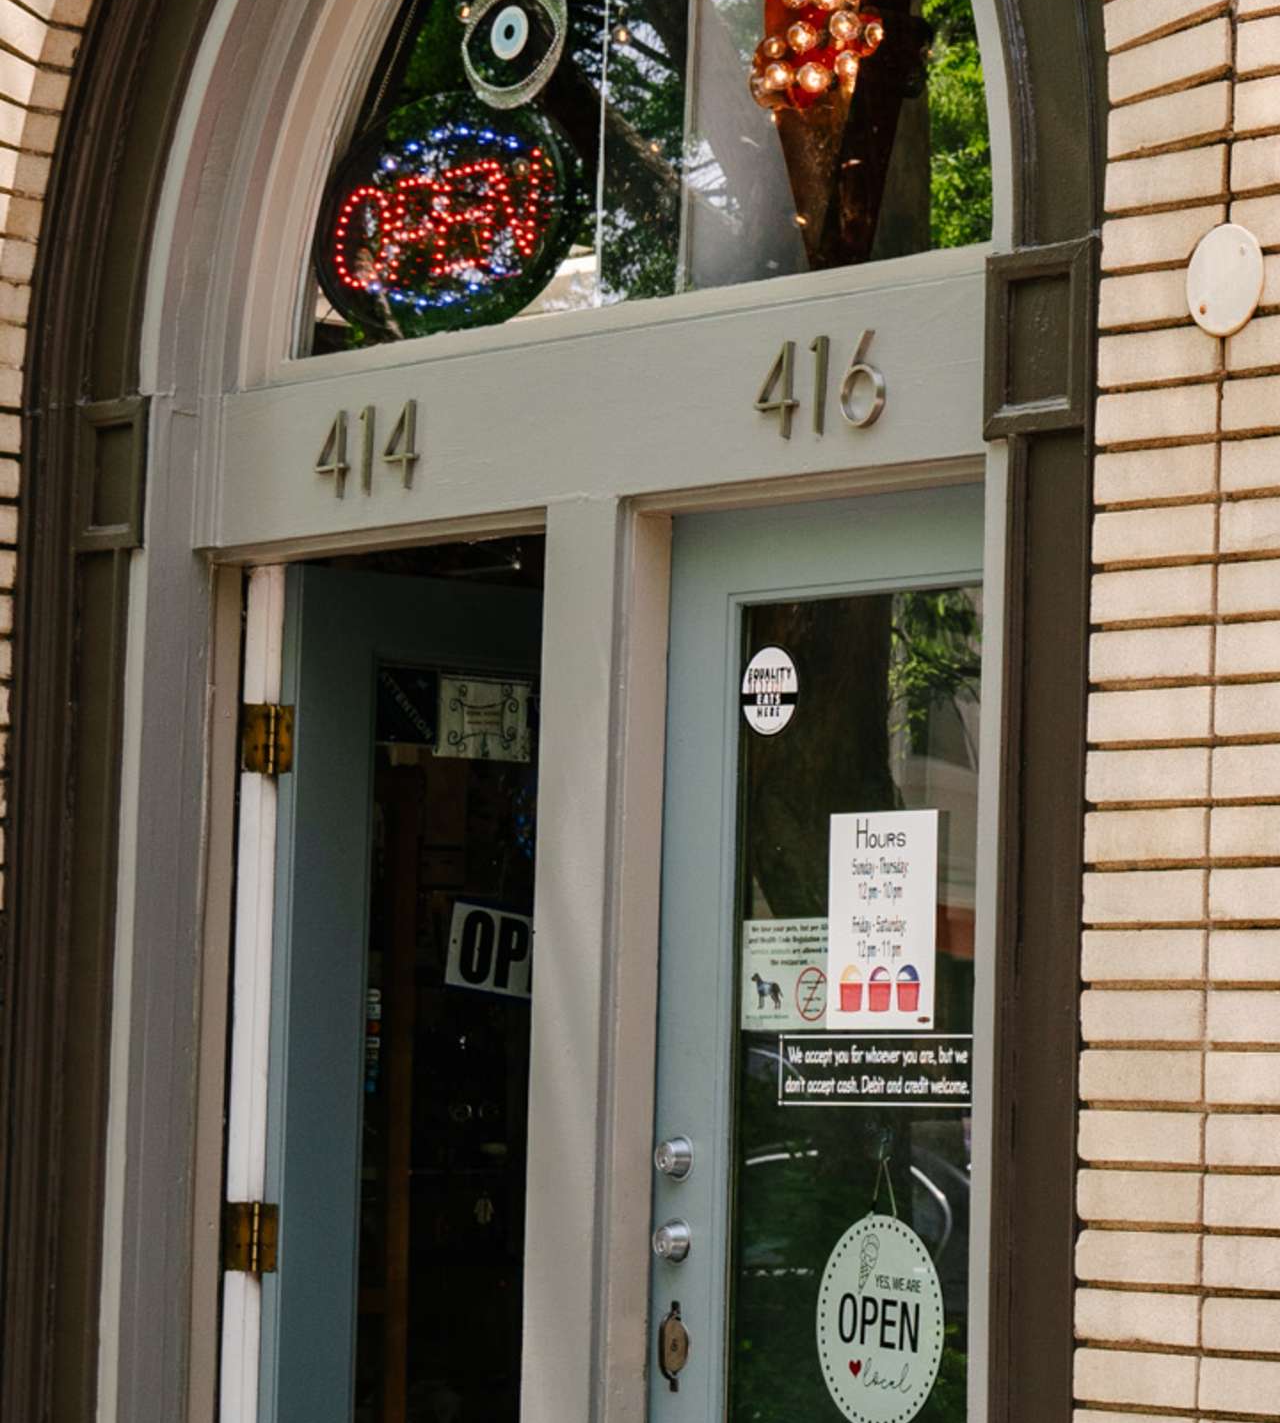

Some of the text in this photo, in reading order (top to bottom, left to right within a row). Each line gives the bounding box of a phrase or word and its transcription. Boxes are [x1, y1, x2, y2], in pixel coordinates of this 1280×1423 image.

[334, 146, 544, 290] OPEN
[754, 329, 886, 439] 416
[313, 399, 420, 499] 414
[748, 666, 792, 683] EQUALITY
[757, 694, 781, 706] EATS
[757, 706, 780, 718] HERE
[788, 1044, 969, 1068] We accept you for whoever you are, but we
[807, 1076, 836, 1096] accept
[837, 1076, 860, 1094] cash.
[861, 1075, 885, 1094] Debit
[886, 1076, 903, 1094] and
[905, 1075, 930, 1094] credit
[931, 1076, 970, 1095] welcome.
[875, 1273, 922, 1294] YES, WE ARE
[838, 1292, 920, 1354] OPEN
[862, 1357, 914, 1394] local
